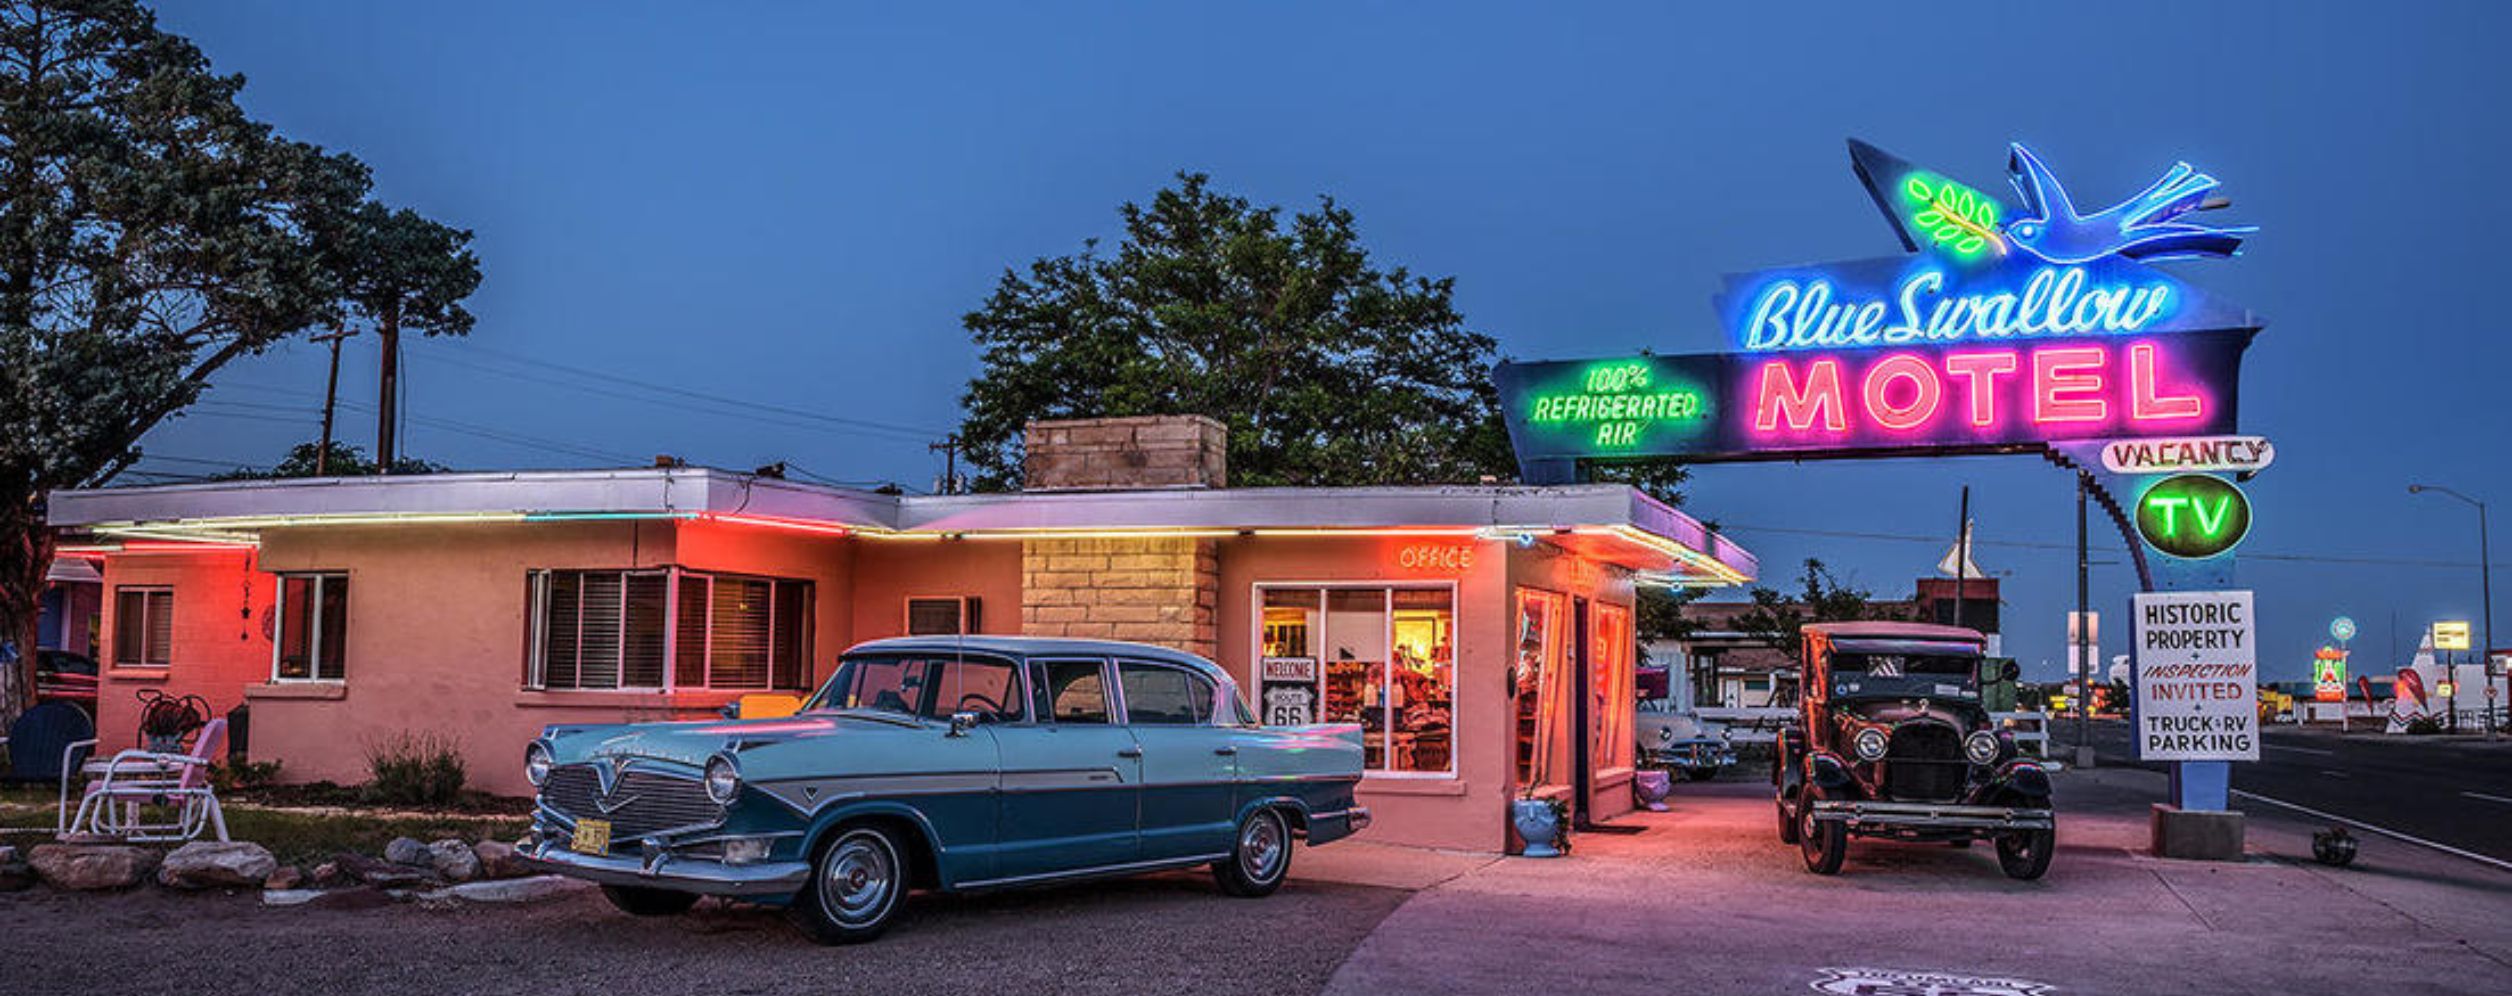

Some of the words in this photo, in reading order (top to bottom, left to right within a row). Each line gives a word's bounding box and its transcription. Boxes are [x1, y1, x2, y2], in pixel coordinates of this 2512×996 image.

[1746, 283, 1886, 349] Blue
[1884, 267, 2169, 341] Swallow
[1586, 365, 1648, 392] 100%
[1756, 344, 2201, 431] MOTEL
[1534, 392, 1697, 421] REFRIGERATED
[1596, 421, 1637, 446] AIR
[2112, 439, 2269, 467] VACANCY
[2148, 495, 2230, 536] TV
[1400, 547, 1473, 568] OFFICE
[2145, 602, 2242, 625] HISTORIC
[2146, 629, 2245, 650] PROPERTY
[1265, 661, 1311, 678] WELCOME
[2142, 663, 2253, 679] INSPECTION
[2151, 682, 2243, 701] INVITED
[1275, 707, 1302, 726] 66
[2147, 716, 2213, 732] TRUCK
[2223, 716, 2249, 732] RV
[2149, 734, 2251, 751] PARKING
